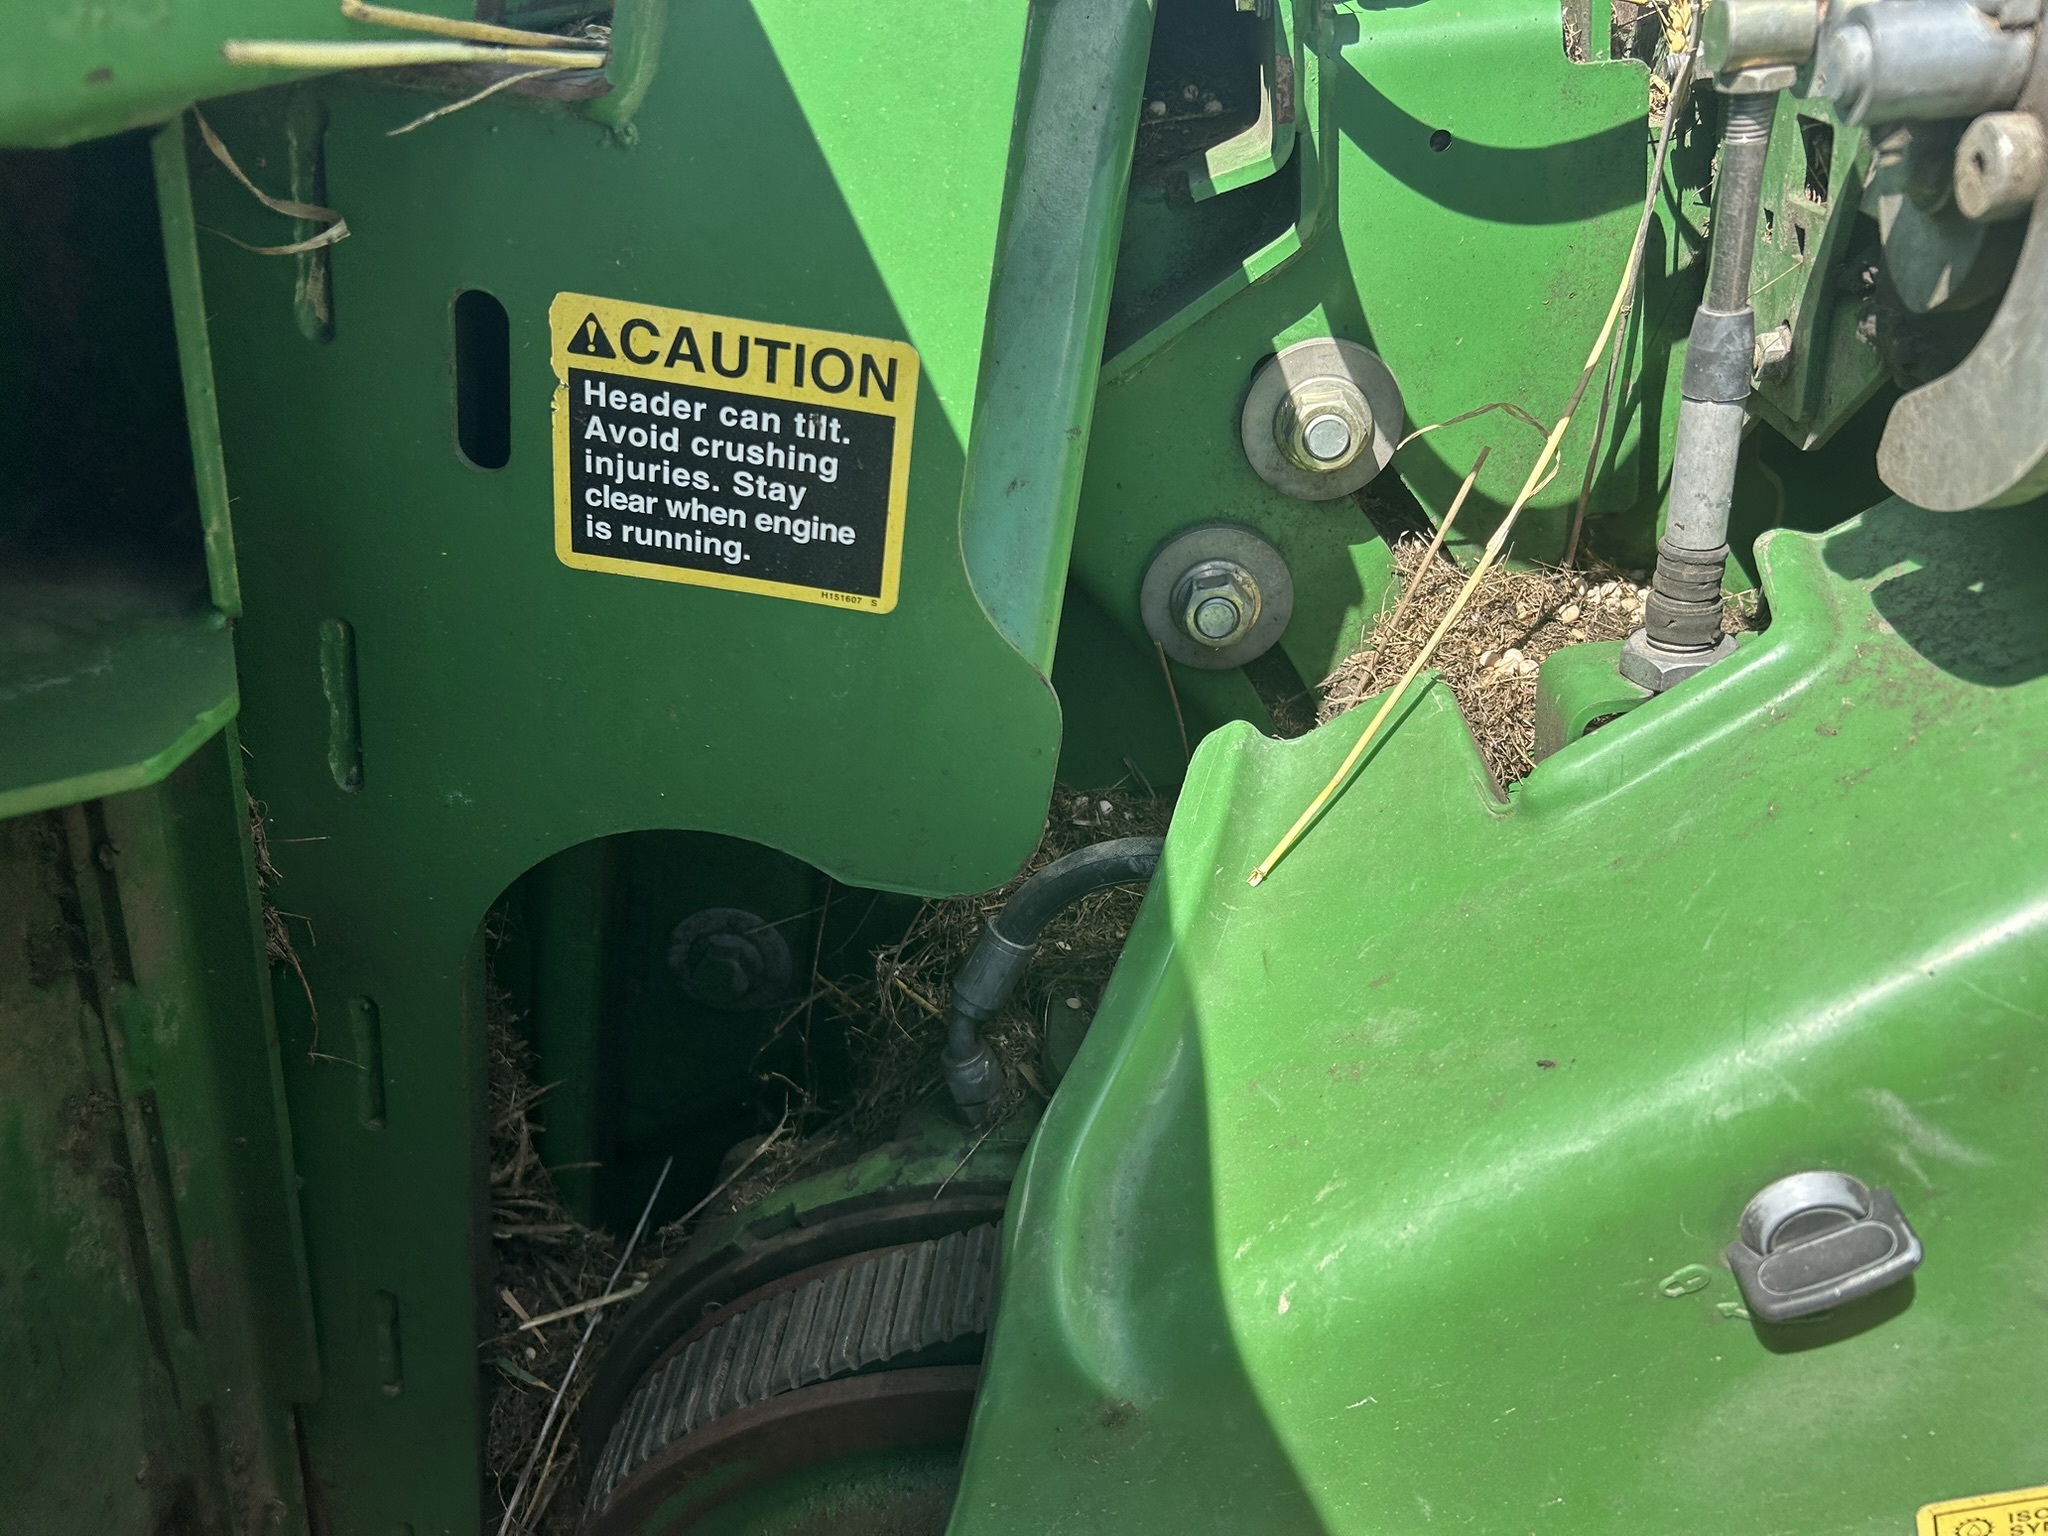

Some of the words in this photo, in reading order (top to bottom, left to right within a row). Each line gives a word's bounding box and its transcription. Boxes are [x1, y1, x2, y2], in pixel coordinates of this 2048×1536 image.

[620, 319, 898, 402] CAUTION
[584, 380, 707, 422] Header
[719, 405, 781, 435] can
[794, 414, 851, 444] tilt.
[584, 415, 680, 453] Avoid
[691, 436, 839, 483] crushing
[585, 450, 720, 492] injuries.
[732, 472, 807, 511] Stay
[585, 486, 659, 515] clear
[666, 497, 746, 529] when
[754, 514, 856, 545] engine
[586, 515, 612, 541] is
[622, 523, 751, 565] running.
[821, 591, 862, 604] H151607
[871, 599, 878, 607] S
